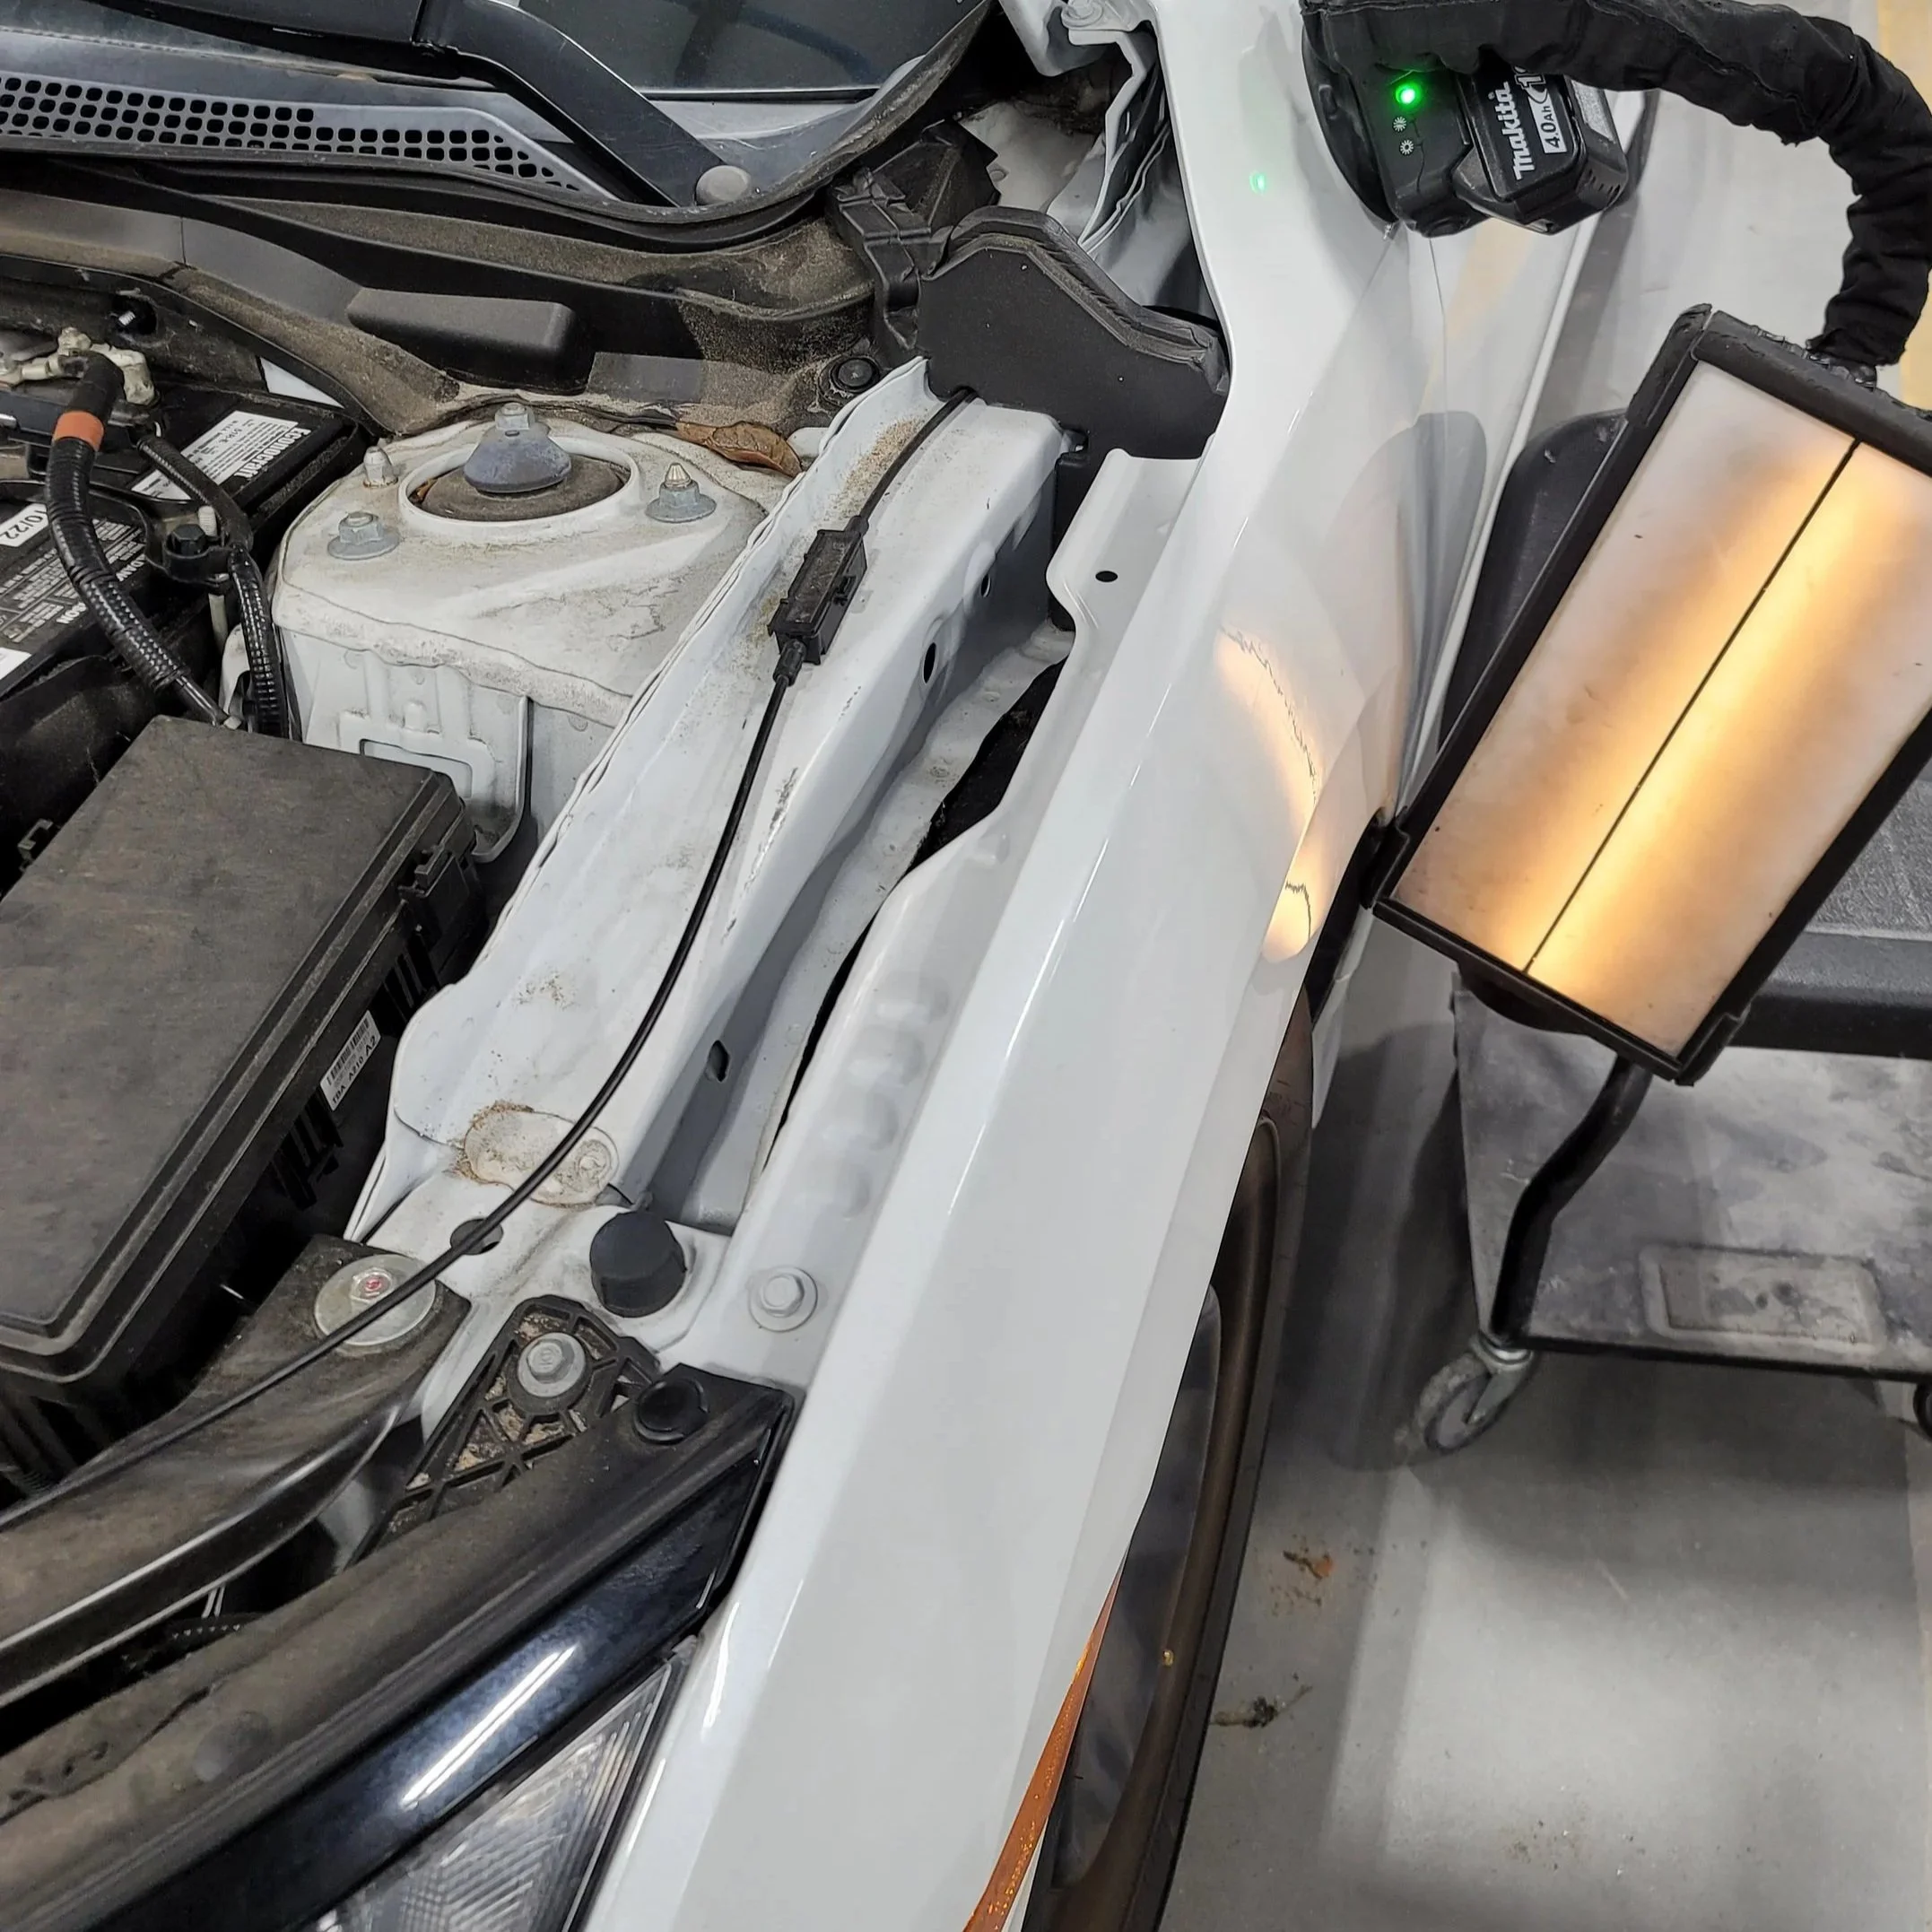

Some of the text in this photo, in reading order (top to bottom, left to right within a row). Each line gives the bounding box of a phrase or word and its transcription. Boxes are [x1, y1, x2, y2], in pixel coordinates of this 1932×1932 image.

[1542, 106, 1562, 148] 4.0Ah
[234, 428, 311, 477] Econocraft
[5, 509, 48, 540] 10/22
[365, 1036, 376, 1057] A2
